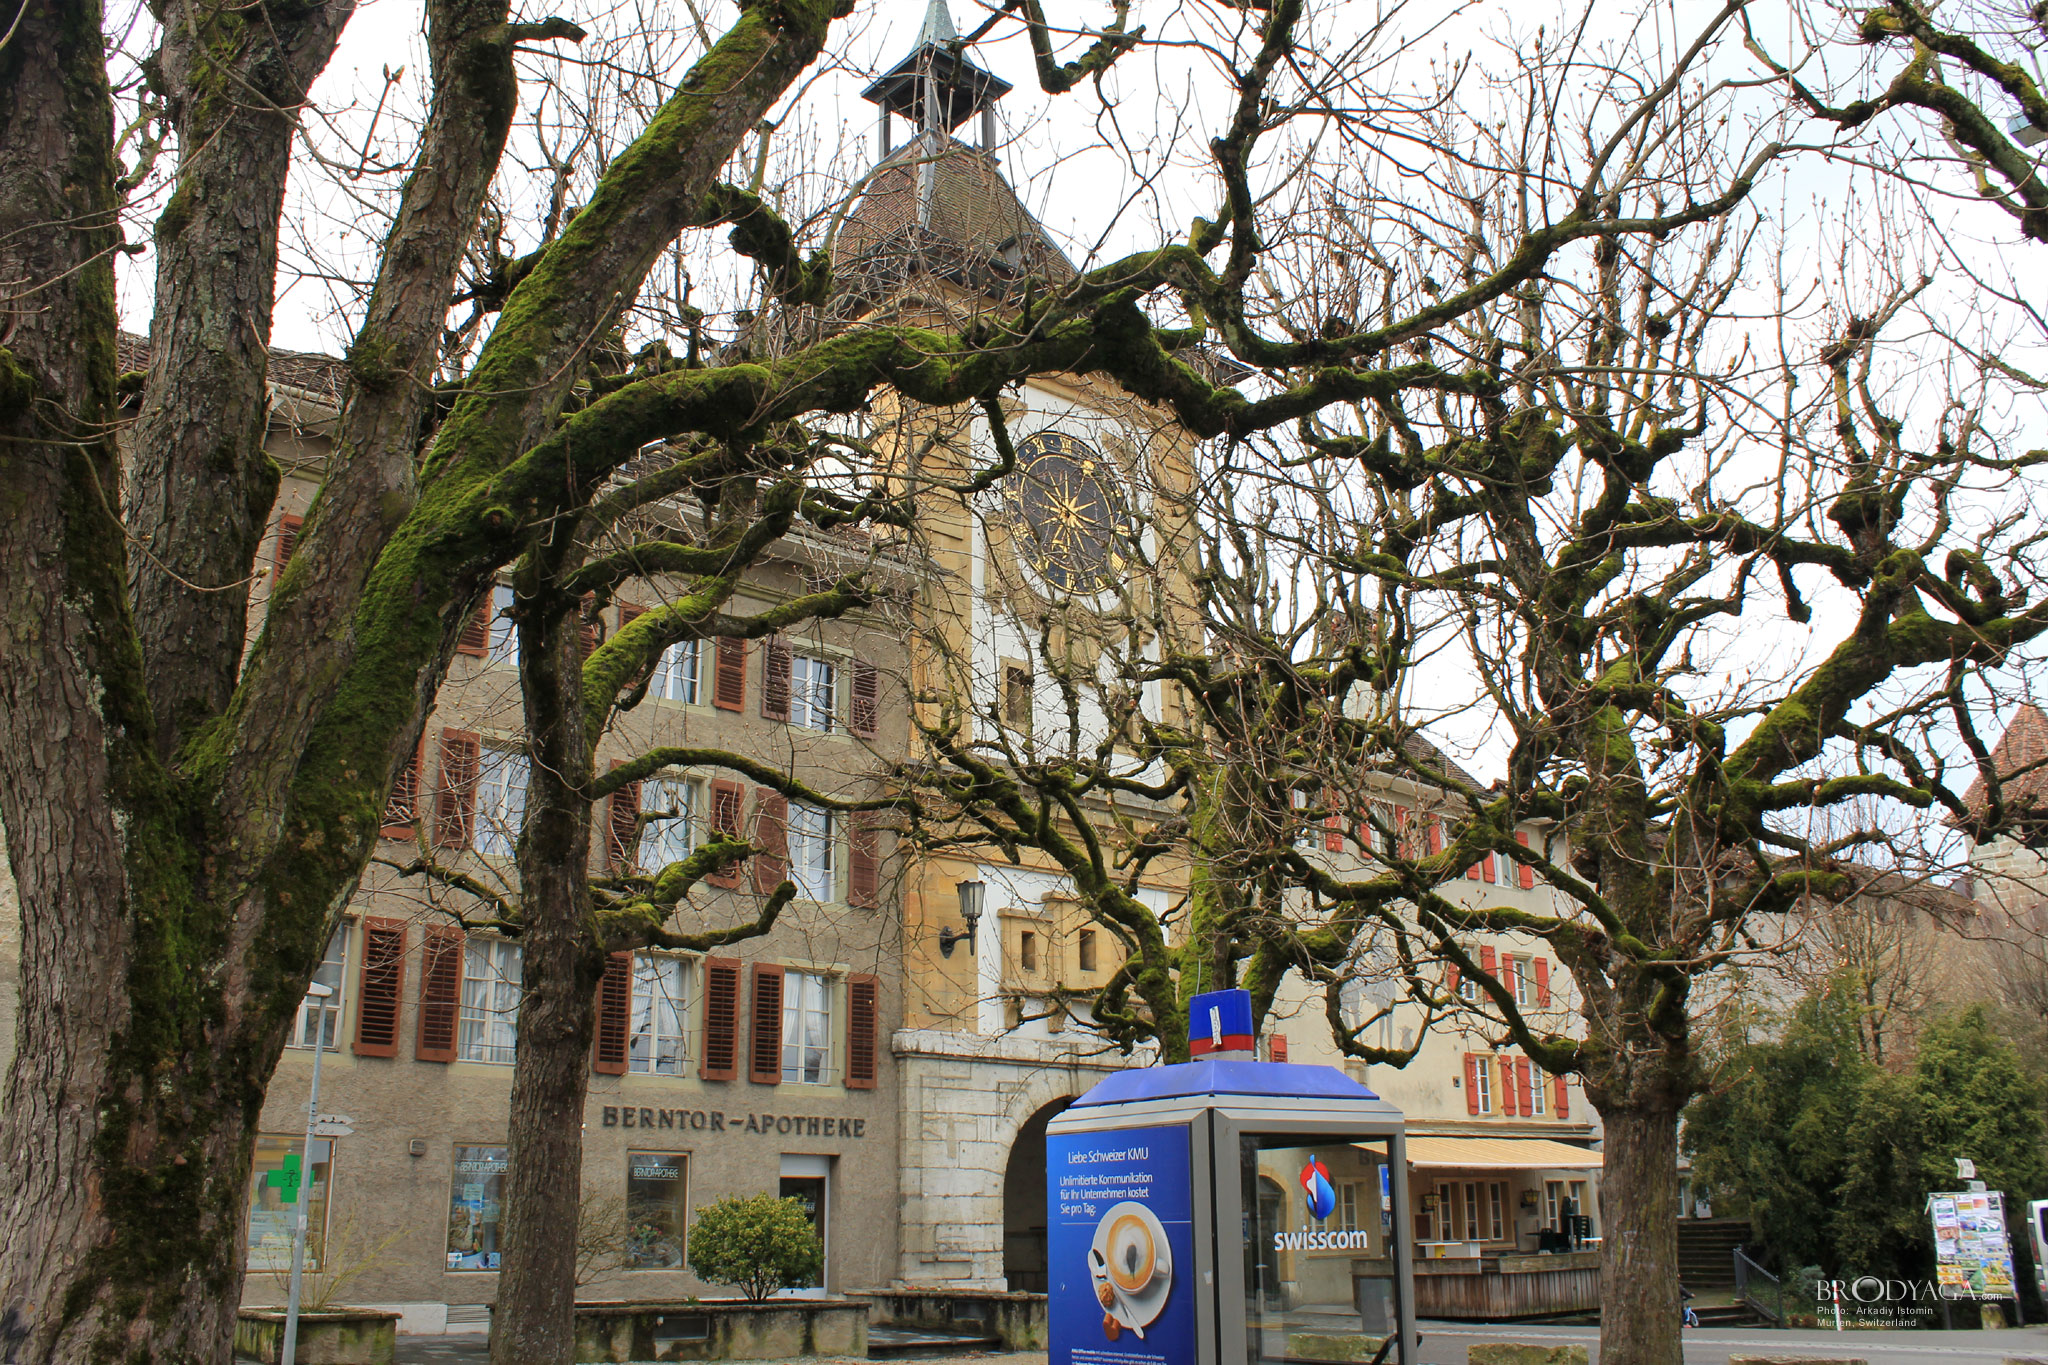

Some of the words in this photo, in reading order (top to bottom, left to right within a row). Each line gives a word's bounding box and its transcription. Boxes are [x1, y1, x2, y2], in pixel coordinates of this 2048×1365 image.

[1068, 1151, 1088, 1164] Liebe
[1088, 1149, 1126, 1163] Schweizer
[1128, 1146, 1149, 1161] KMU
[459, 1161, 508, 1173] BERNTOR-APOTHEK
[1060, 1174, 1098, 1186] Unlimitierte
[1099, 1172, 1153, 1184] Kommunikation
[1060, 1188, 1070, 1200] für
[1071, 1188, 1080, 1200] Ihr
[1081, 1187, 1126, 1199] Unternehmen
[1128, 1186, 1149, 1198] kostet
[1060, 1203, 1070, 1214] Sie
[1071, 1204, 1082, 1216] pro
[1083, 1203, 1096, 1216] Tag:
[1274, 1224, 1368, 1252] swisscom
